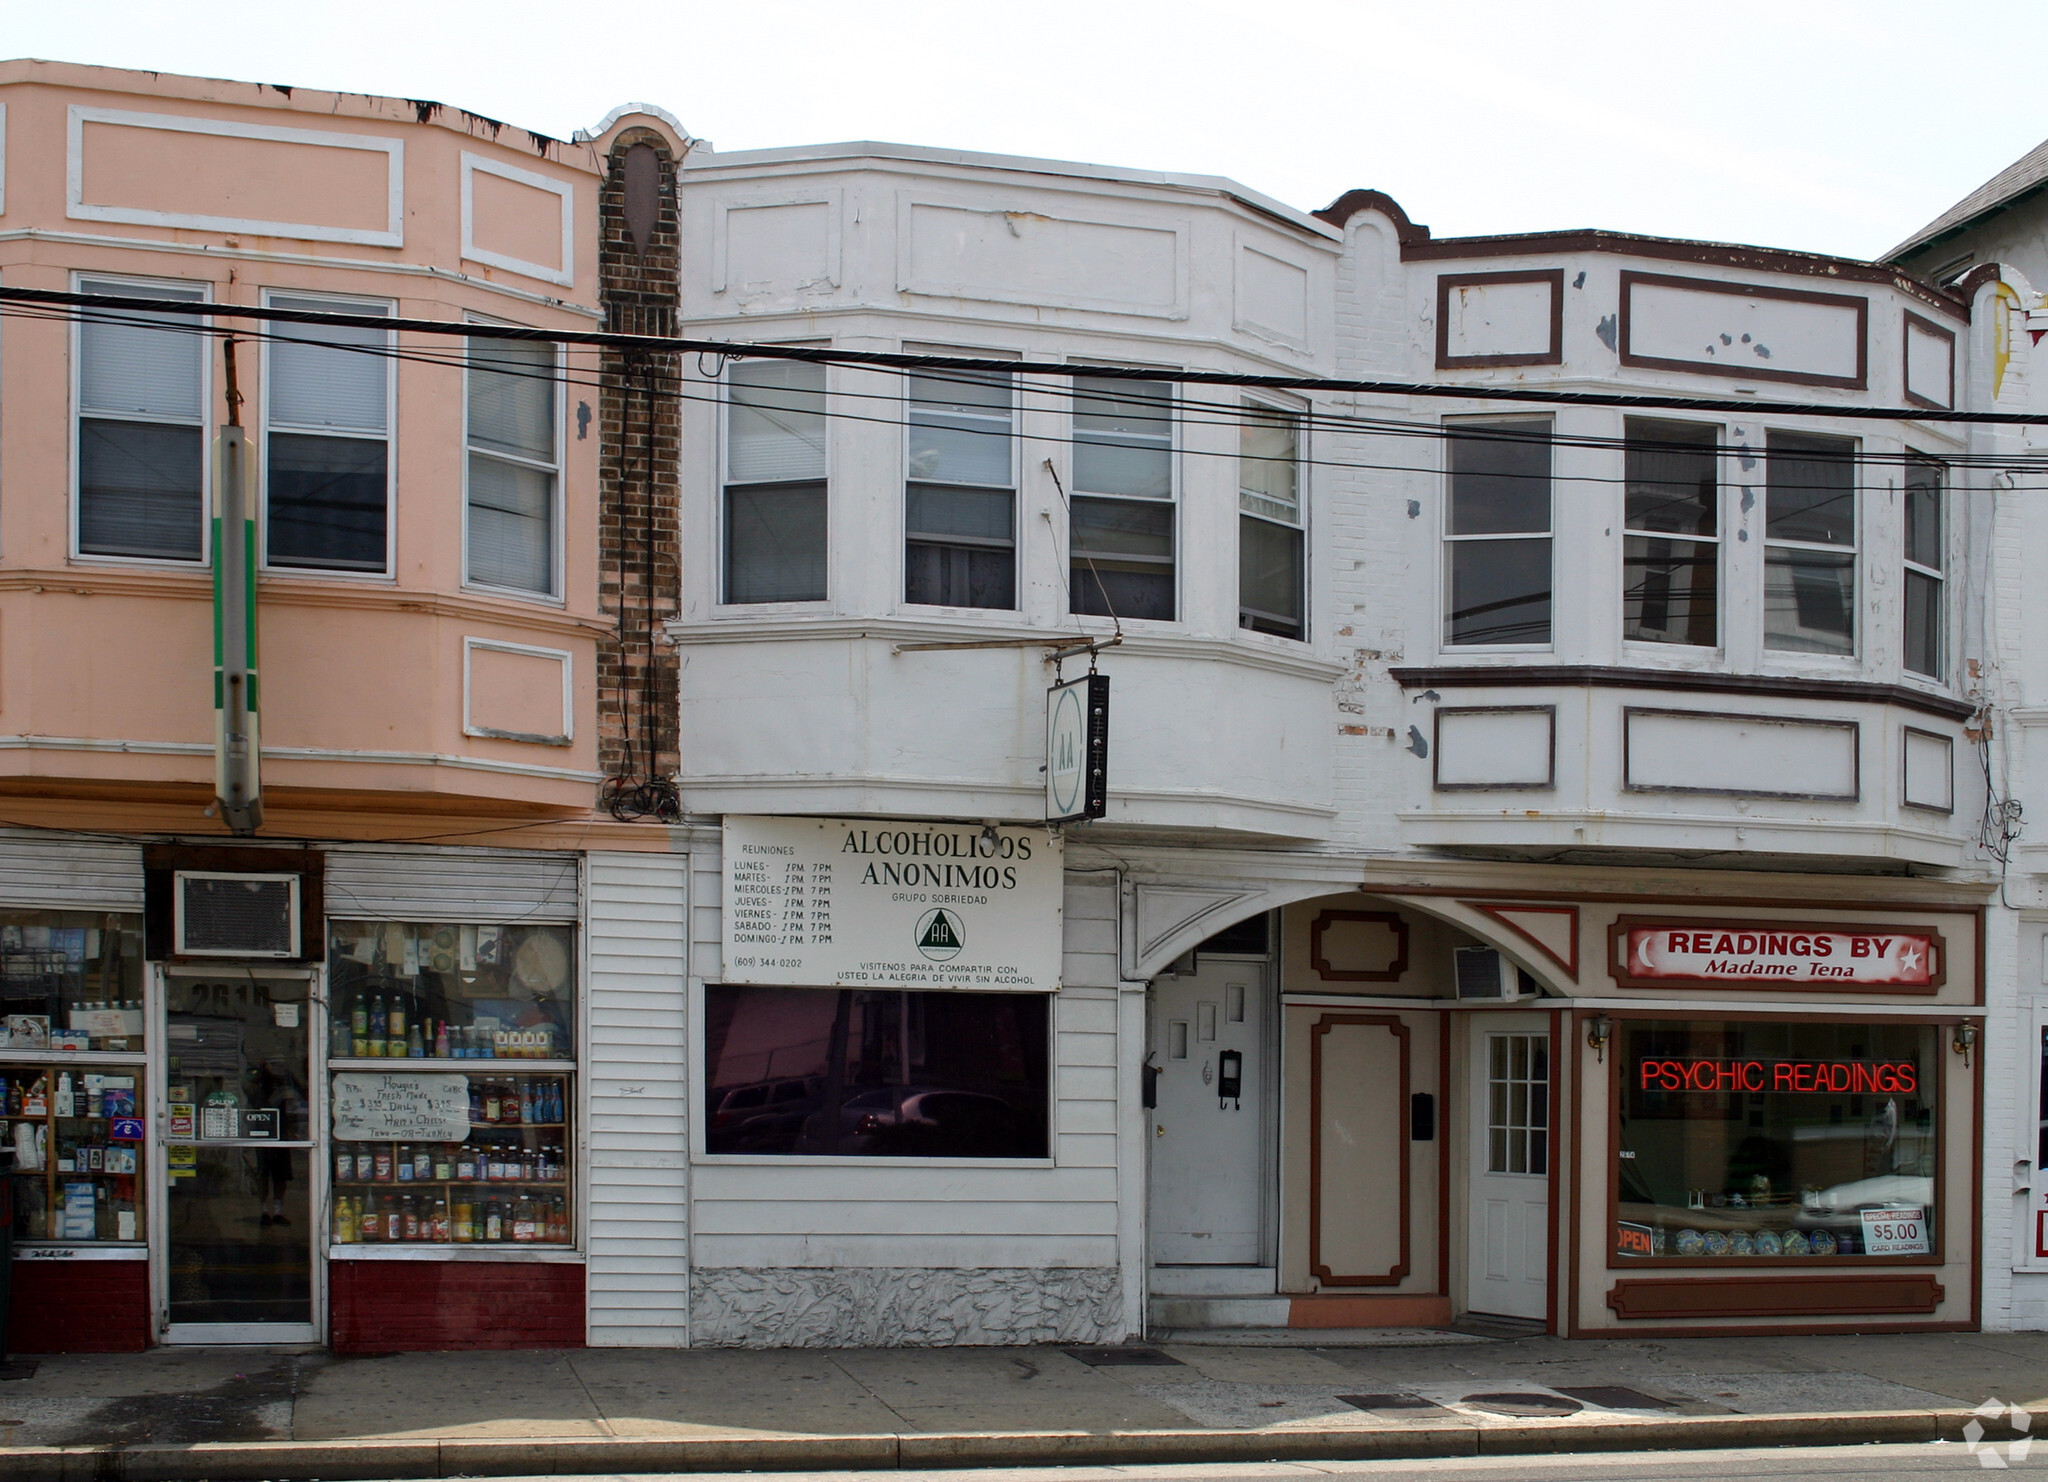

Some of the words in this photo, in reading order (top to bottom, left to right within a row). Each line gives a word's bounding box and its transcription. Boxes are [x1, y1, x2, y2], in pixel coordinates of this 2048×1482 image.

[1059, 731, 1074, 771] AA
[742, 844, 795, 855] REUNIONES
[785, 863, 790, 872] 1
[813, 864, 818, 872] 7
[784, 875, 790, 883] 1
[861, 862, 1017, 889] ANONIMOS
[784, 887, 790, 895] 1
[784, 899, 790, 907] 1
[812, 899, 817, 907] 7
[892, 892, 926, 902] GRUPO
[932, 894, 988, 905] SOBRIEDAD
[783, 911, 788, 919] 1
[782, 923, 788, 931] 1
[811, 923, 816, 931] 7
[931, 922, 949, 943] AA
[781, 936, 786, 944] 1
[812, 935, 817, 944] 7
[1668, 932, 1833, 958] READINGS
[1851, 938, 1892, 959] BY
[734, 956, 756, 968] (609)
[760, 958, 802, 968] 344-0202
[860, 962, 906, 971] VISITENOS
[910, 964, 934, 972] PARA
[939, 964, 992, 973] COMPARTIR
[997, 966, 1018, 974] CON
[1704, 959, 1798, 976] Madame
[1809, 962, 1855, 977] Tena
[838, 972, 868, 980] USTED
[872, 972, 885, 980] LA
[889, 973, 928, 982] ALEGRIA
[933, 974, 944, 982] DE
[948, 975, 971, 983] VIVIR
[994, 976, 1035, 985] ALCOHOL
[1642, 1060, 1764, 1091] PSYCHIC
[1774, 1062, 1916, 1093] READINGS
[1874, 1223, 1917, 1240] $5.00
